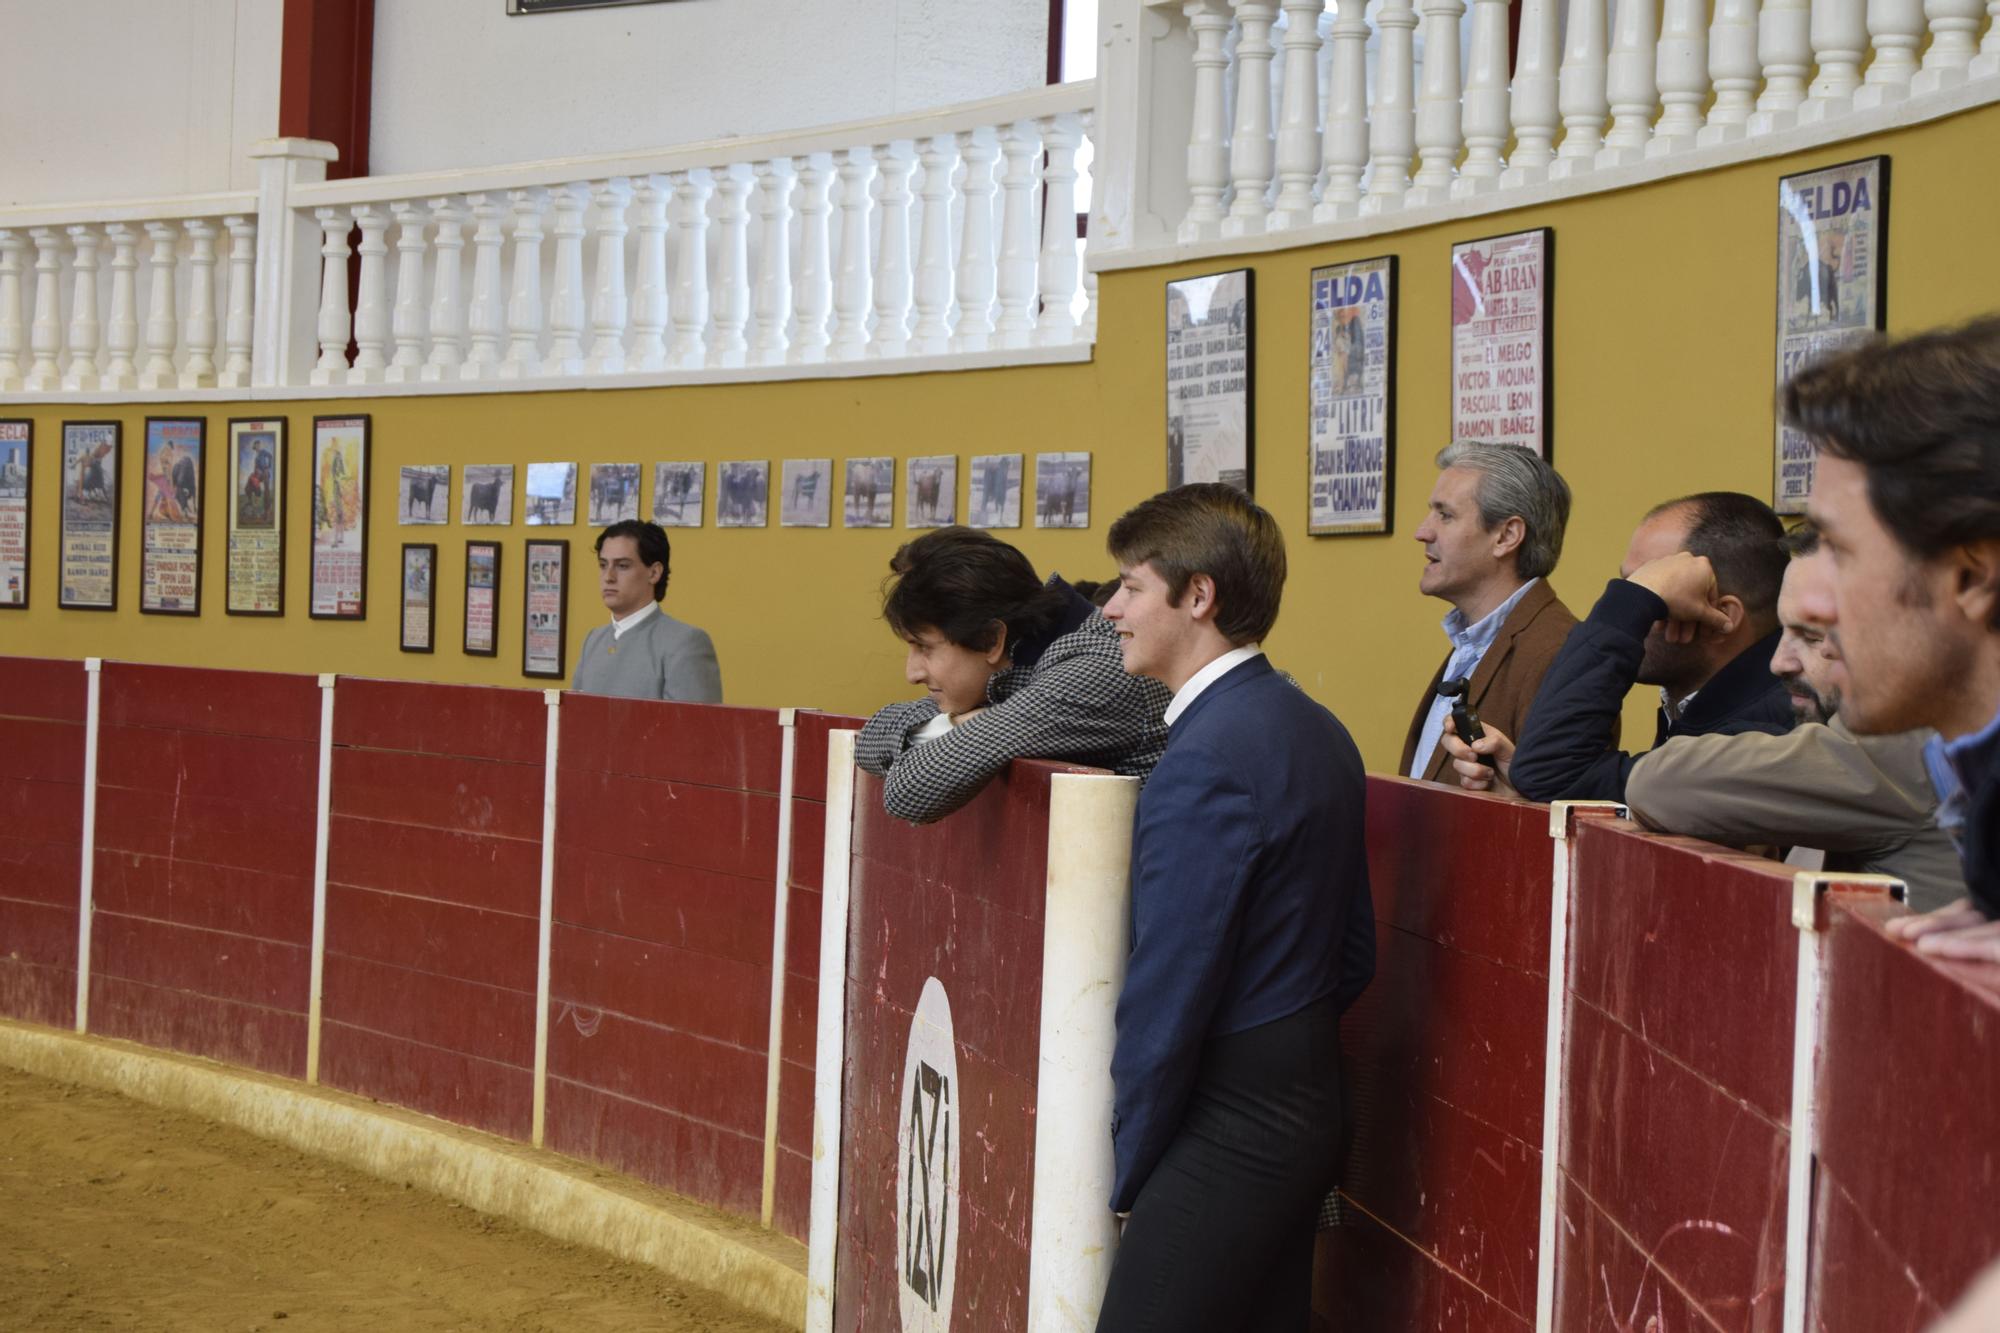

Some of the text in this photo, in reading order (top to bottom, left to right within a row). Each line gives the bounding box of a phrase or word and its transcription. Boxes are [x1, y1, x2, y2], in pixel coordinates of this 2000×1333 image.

[1791, 177, 1871, 222] ELDA
[1316, 271, 1384, 310] ELDA
[1486, 264, 1537, 295] ABARAN
[1499, 341, 1532, 362] MELGO
[1458, 366, 1536, 390] VICTOR MOLINA
[1461, 391, 1532, 414] PASCUAL LEON
[1458, 419, 1495, 437] RAMON
[1345, 437, 1382, 473] UBRIQUE
